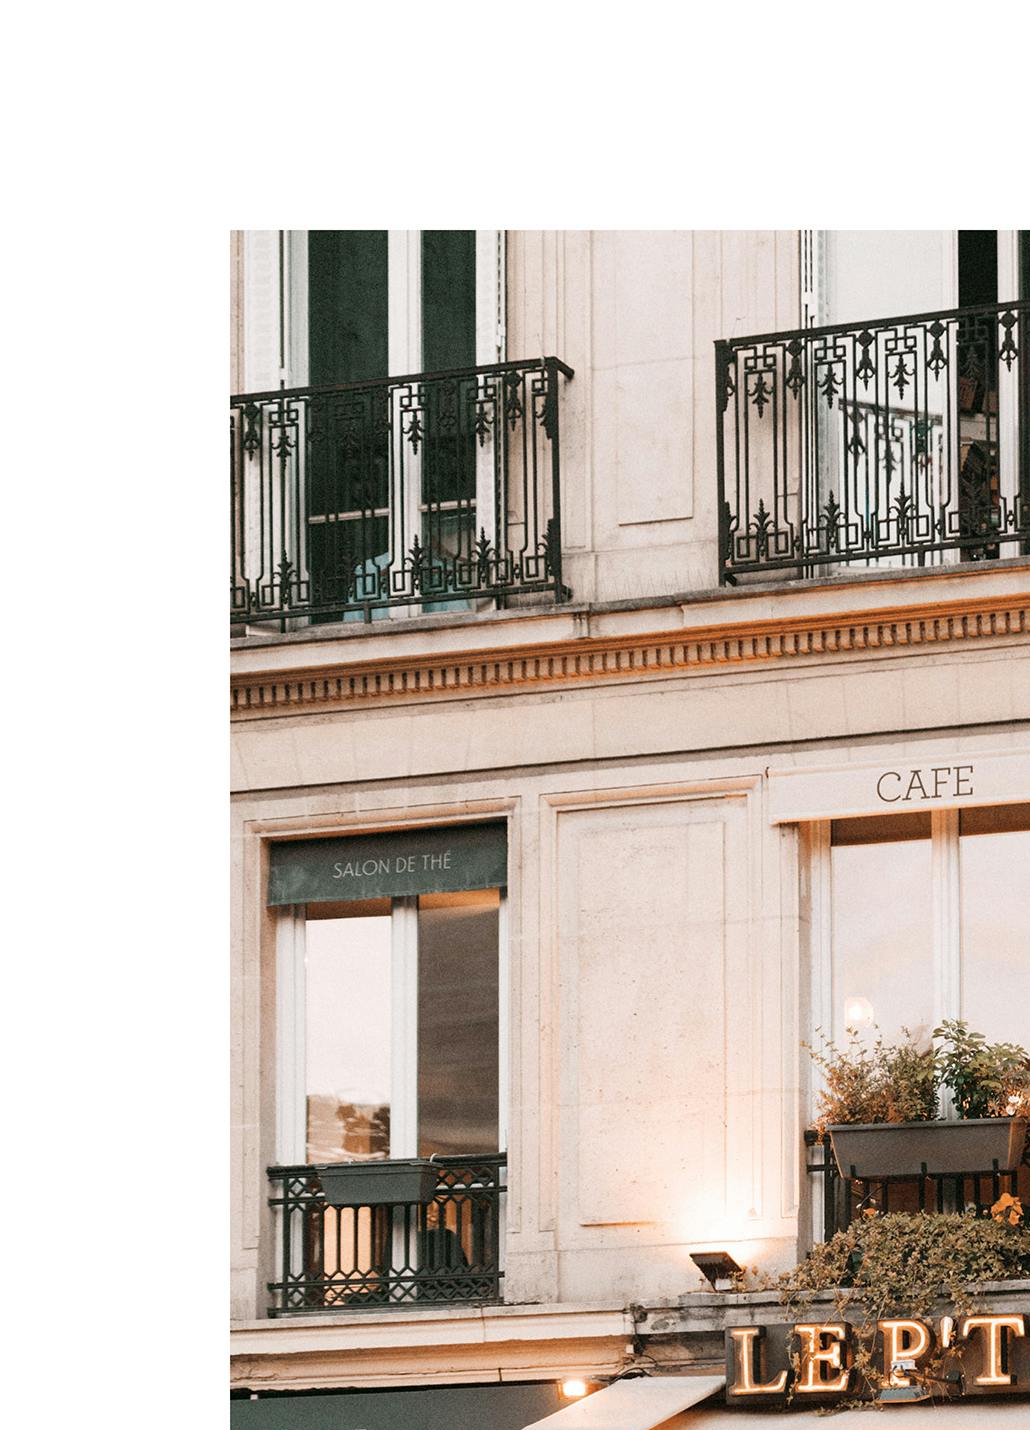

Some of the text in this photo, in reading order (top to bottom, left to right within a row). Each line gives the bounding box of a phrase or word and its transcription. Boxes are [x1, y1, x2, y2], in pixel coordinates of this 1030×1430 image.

[876, 765, 974, 802] CAFE
[332, 850, 451, 879] SALON DE THÉ
[727, 1319, 850, 1396] LE
